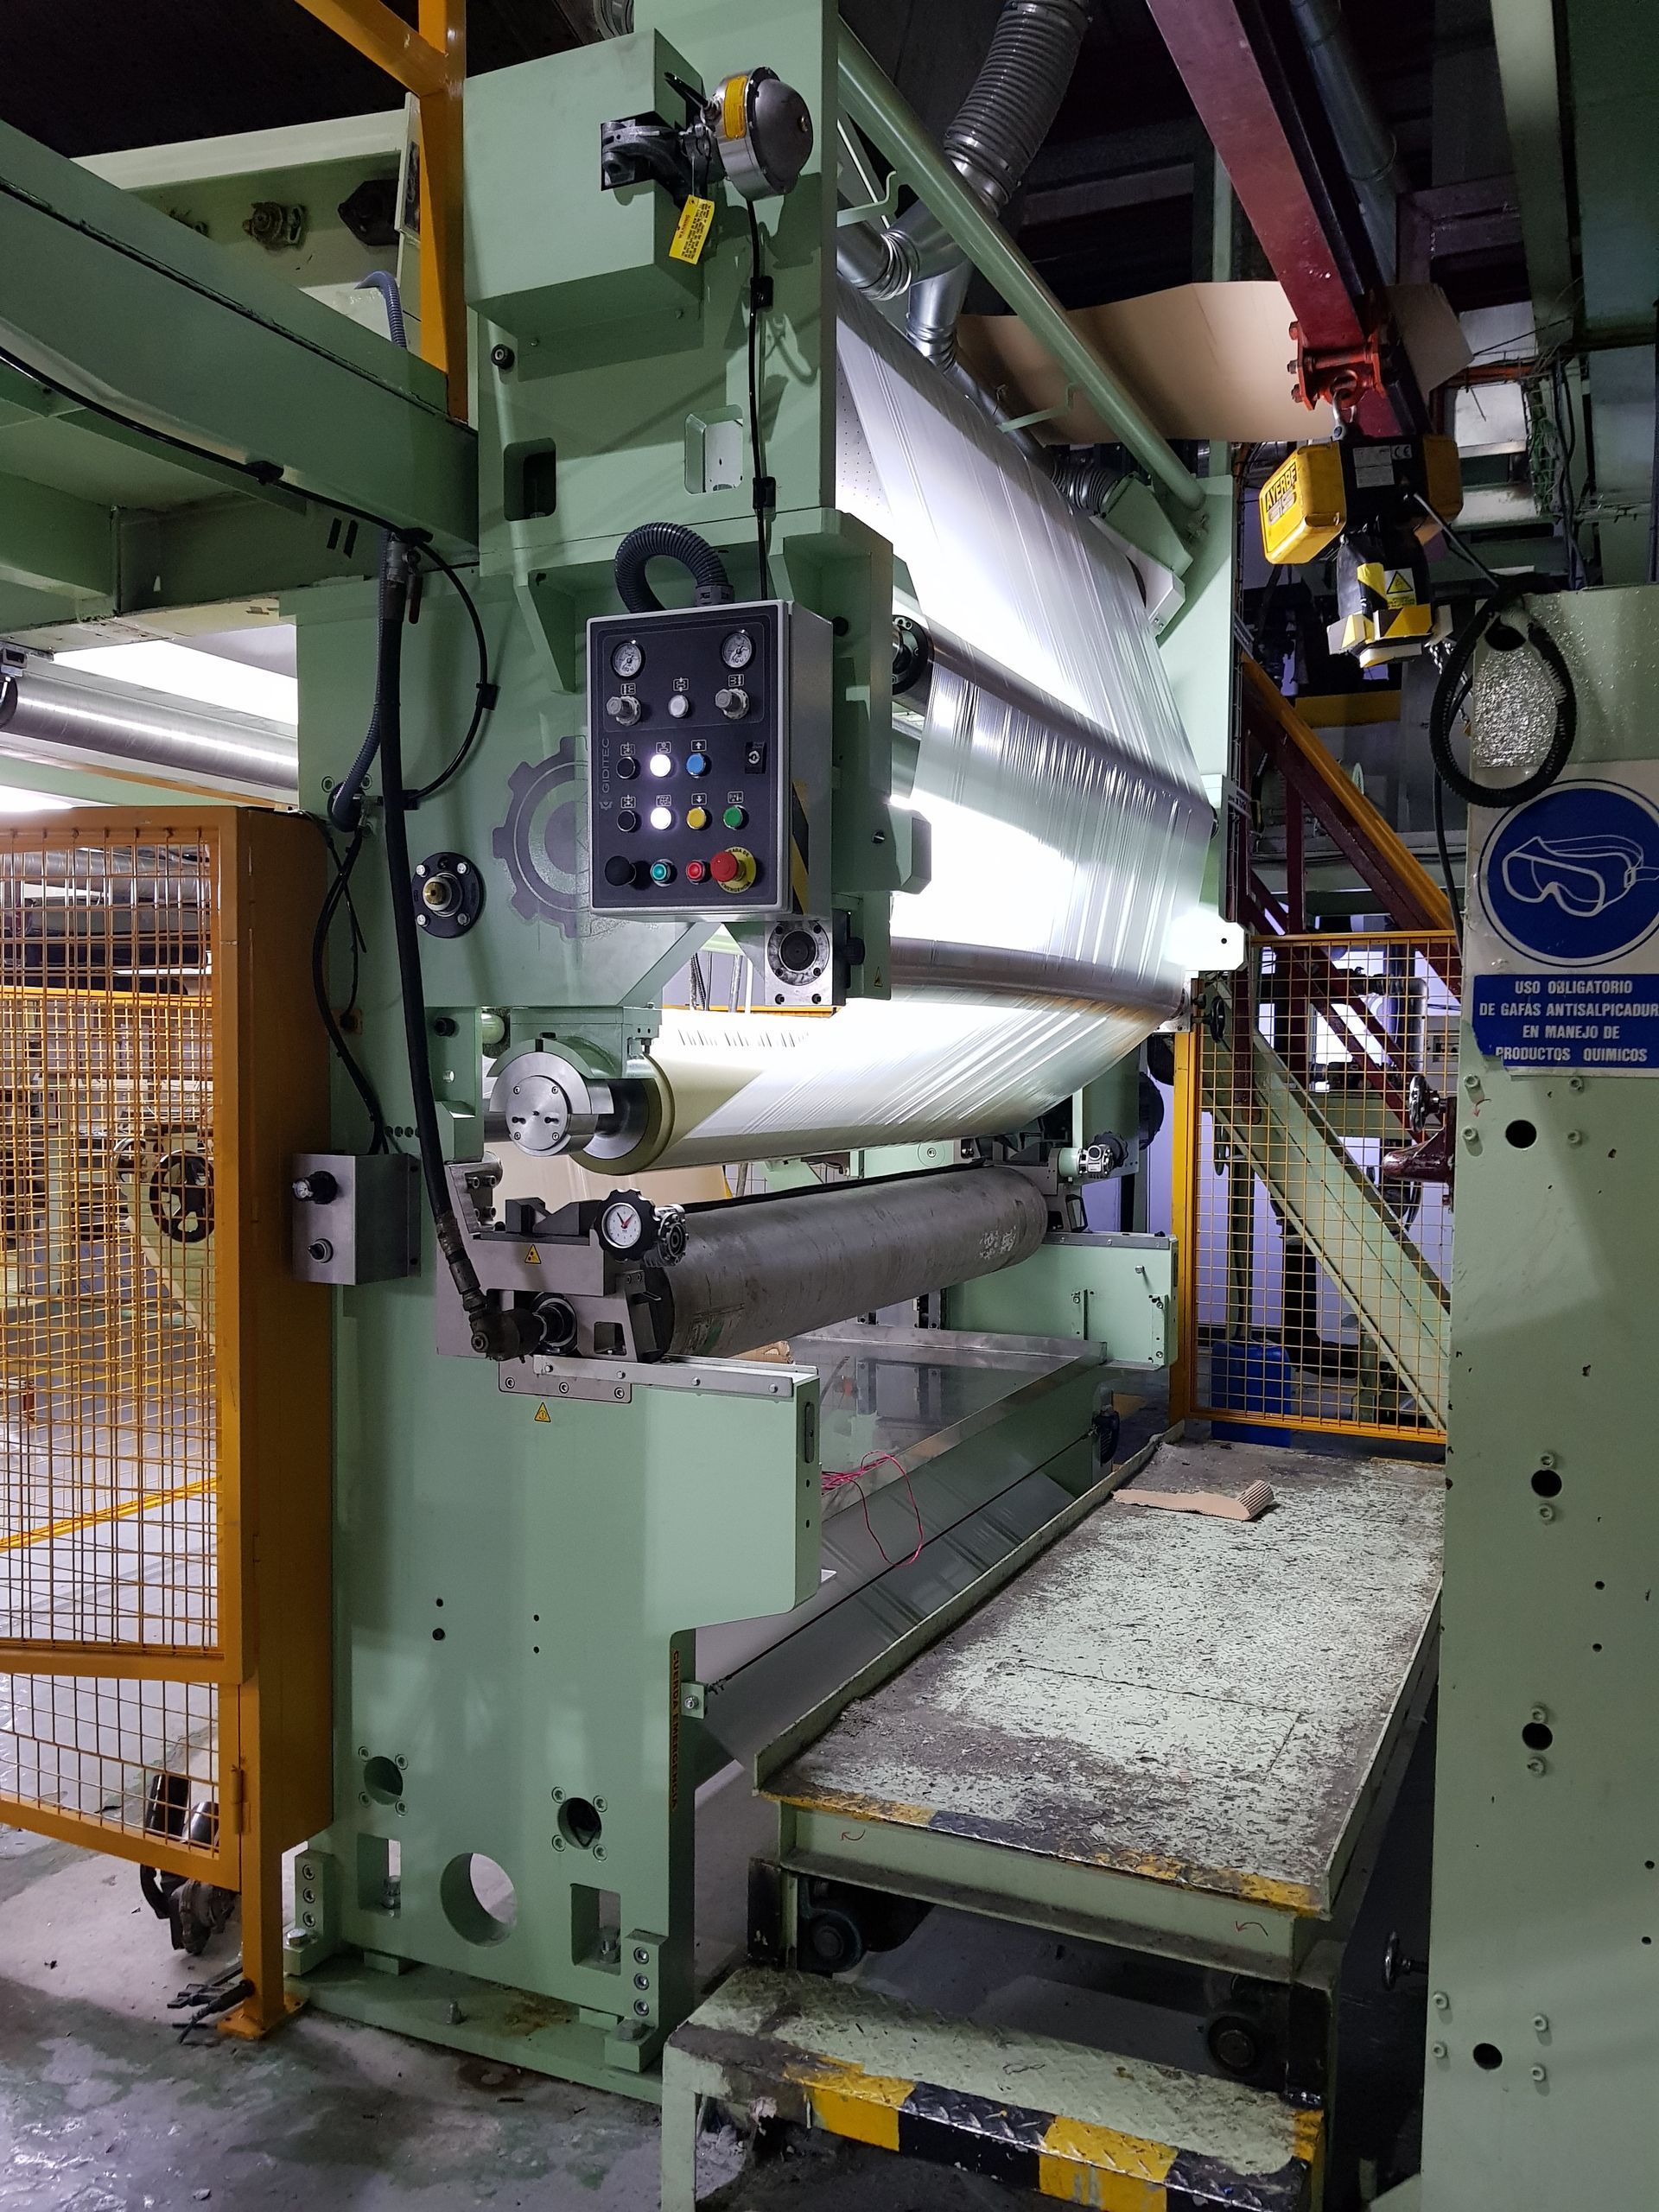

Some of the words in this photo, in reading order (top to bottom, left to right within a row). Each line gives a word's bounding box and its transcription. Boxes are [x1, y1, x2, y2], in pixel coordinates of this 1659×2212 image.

[1265, 462, 1297, 512] AYERBE
[601, 737, 610, 793] GIDITEC
[1515, 980, 1541, 995] USO
[1548, 980, 1632, 995] OBLIGATORIO
[1479, 1002, 1495, 1016] DE
[1500, 1002, 1541, 1017] GAFAS
[1522, 1025, 1539, 1039] EN
[1545, 1025, 1599, 1039] MANEJO
[1603, 1026, 1620, 1039] DE
[1496, 1046, 1571, 1061] PRODUCTOS
[1583, 1047, 1648, 1062] QUIMICOS
